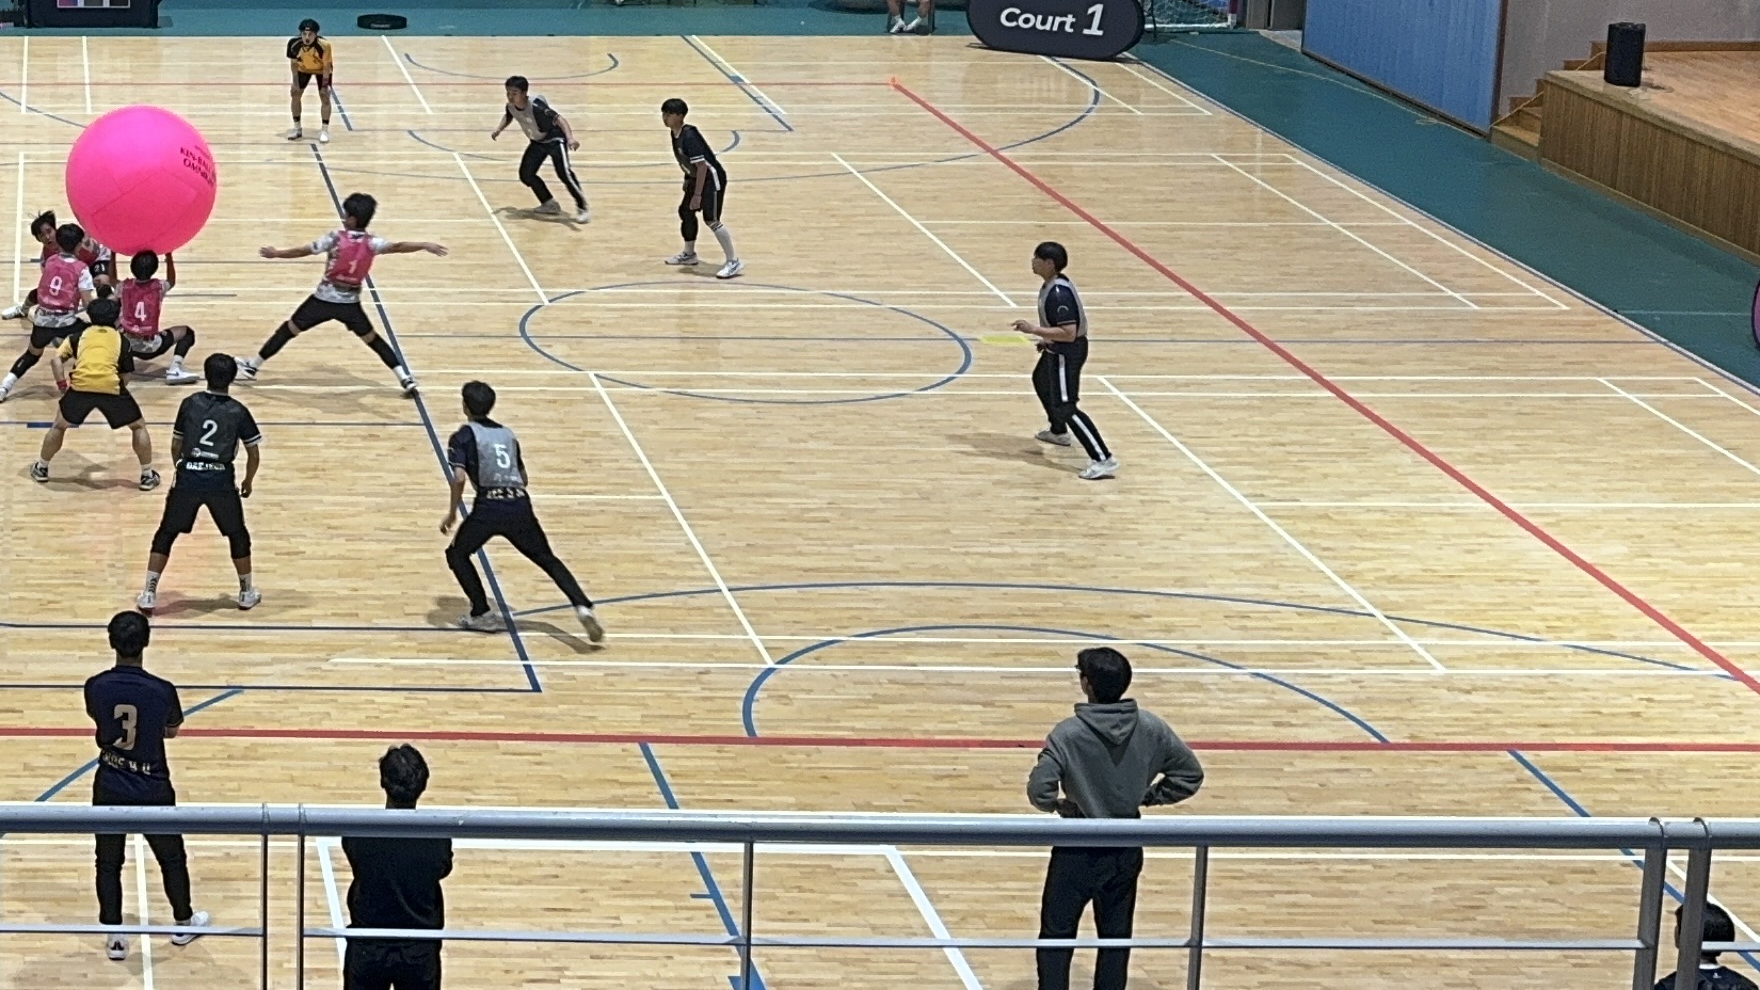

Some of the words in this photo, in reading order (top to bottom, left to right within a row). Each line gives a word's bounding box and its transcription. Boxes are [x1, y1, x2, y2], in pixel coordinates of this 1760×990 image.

[1000, 7, 1076, 33] Court
[1082, 4, 1104, 36] 1
[348, 260, 358, 274] 1
[49, 275, 63, 296] 9
[134, 301, 147, 322] 4
[199, 419, 218, 447] 2
[493, 443, 511, 469] 5
[112, 704, 137, 750] 3
